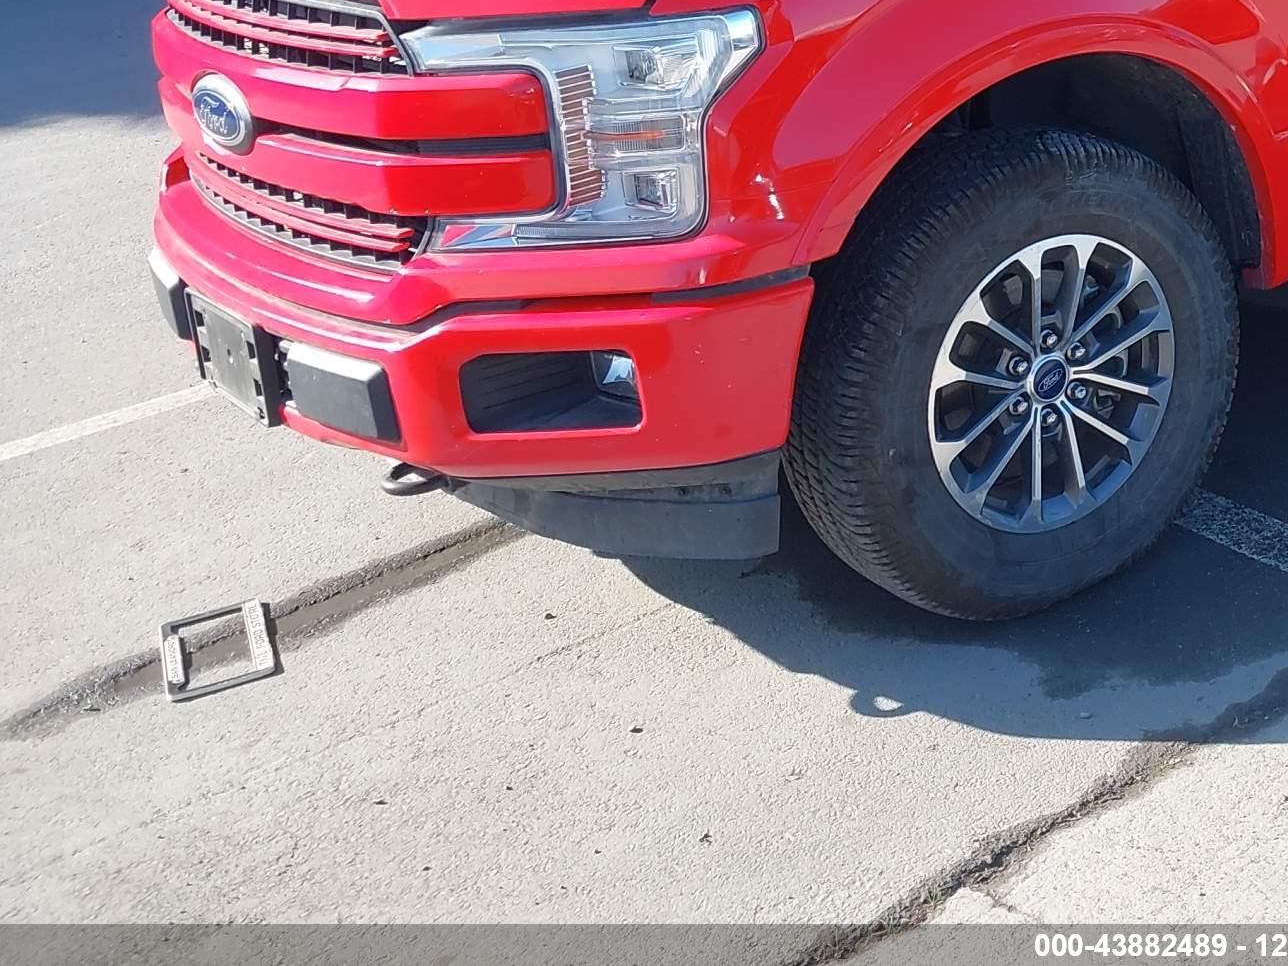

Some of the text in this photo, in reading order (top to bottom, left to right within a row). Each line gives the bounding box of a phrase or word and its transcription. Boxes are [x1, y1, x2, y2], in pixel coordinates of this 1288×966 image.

[199, 95, 230, 135] Ford
[247, 602, 268, 667] THE FORD STORE
